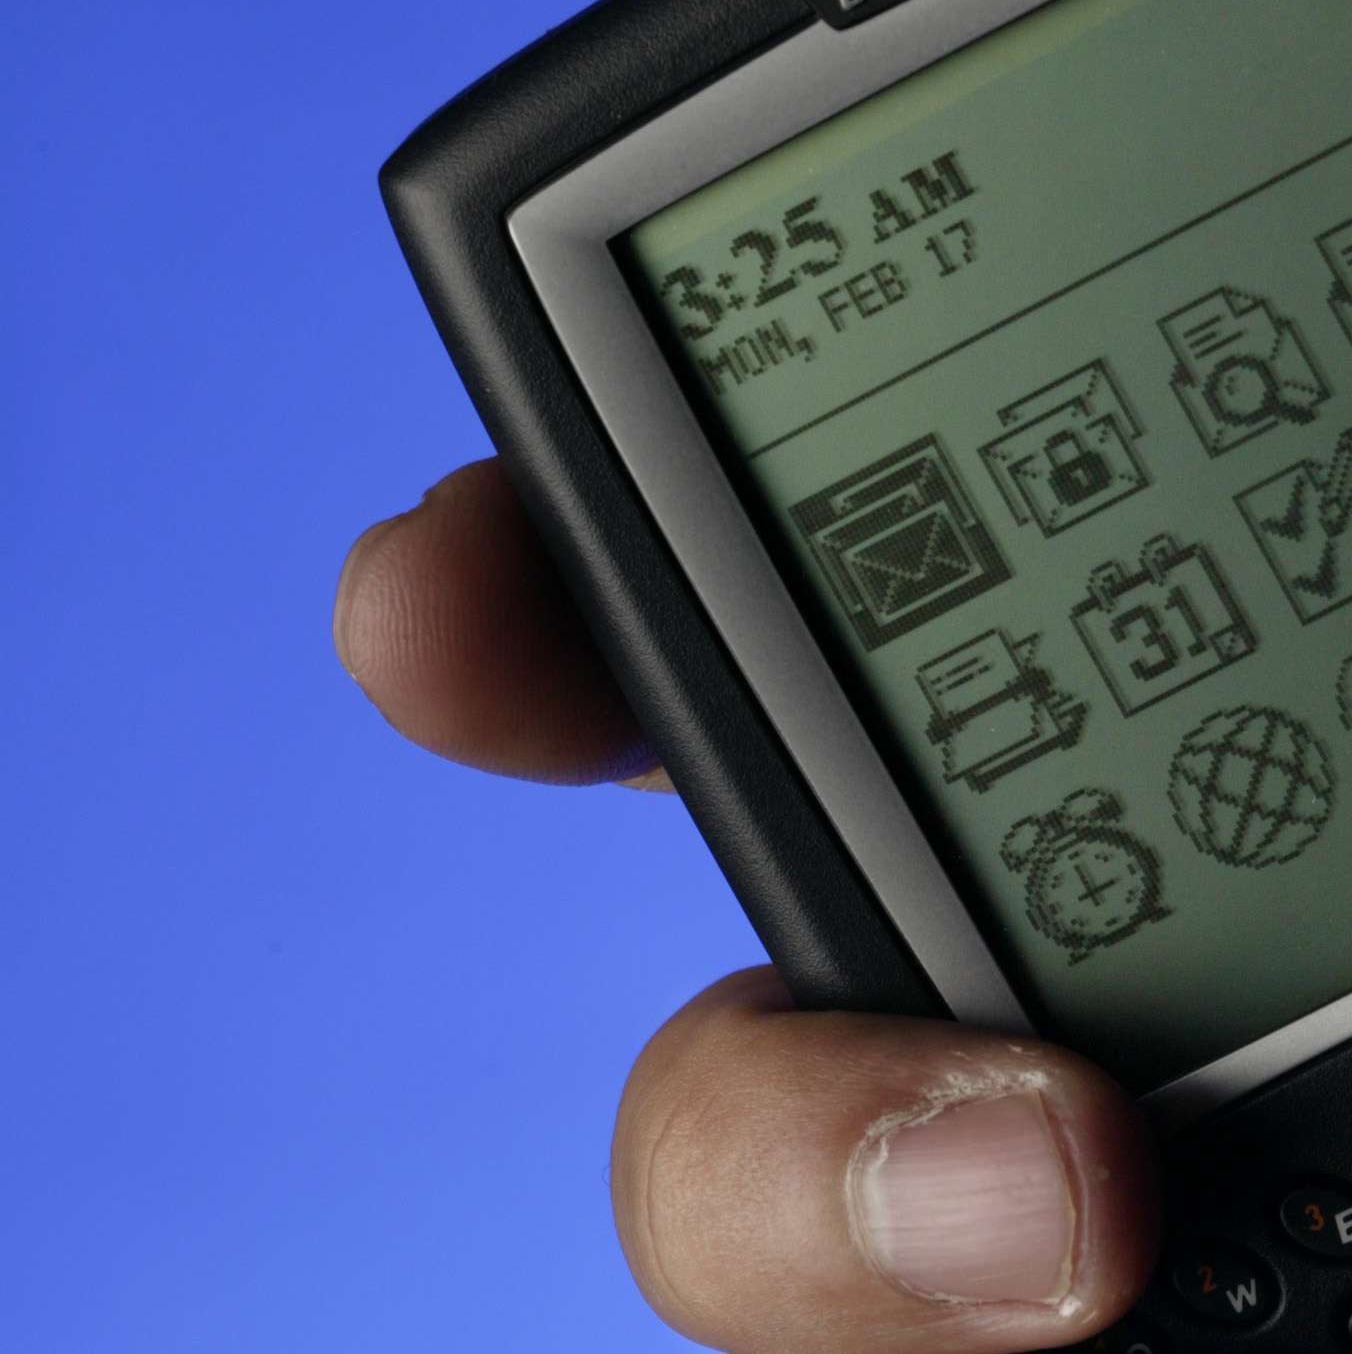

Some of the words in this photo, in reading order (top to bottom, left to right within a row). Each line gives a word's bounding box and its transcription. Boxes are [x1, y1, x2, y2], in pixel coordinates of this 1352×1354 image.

[662, 195, 846, 341] 3:25
[868, 150, 979, 245] AM
[817, 261, 910, 335] FEB
[923, 218, 978, 278] 17
[1110, 586, 1208, 682] 31
[1305, 1203, 1326, 1233] 3
[1199, 1265, 1217, 1295] 2
[1226, 1279, 1257, 1313] W
